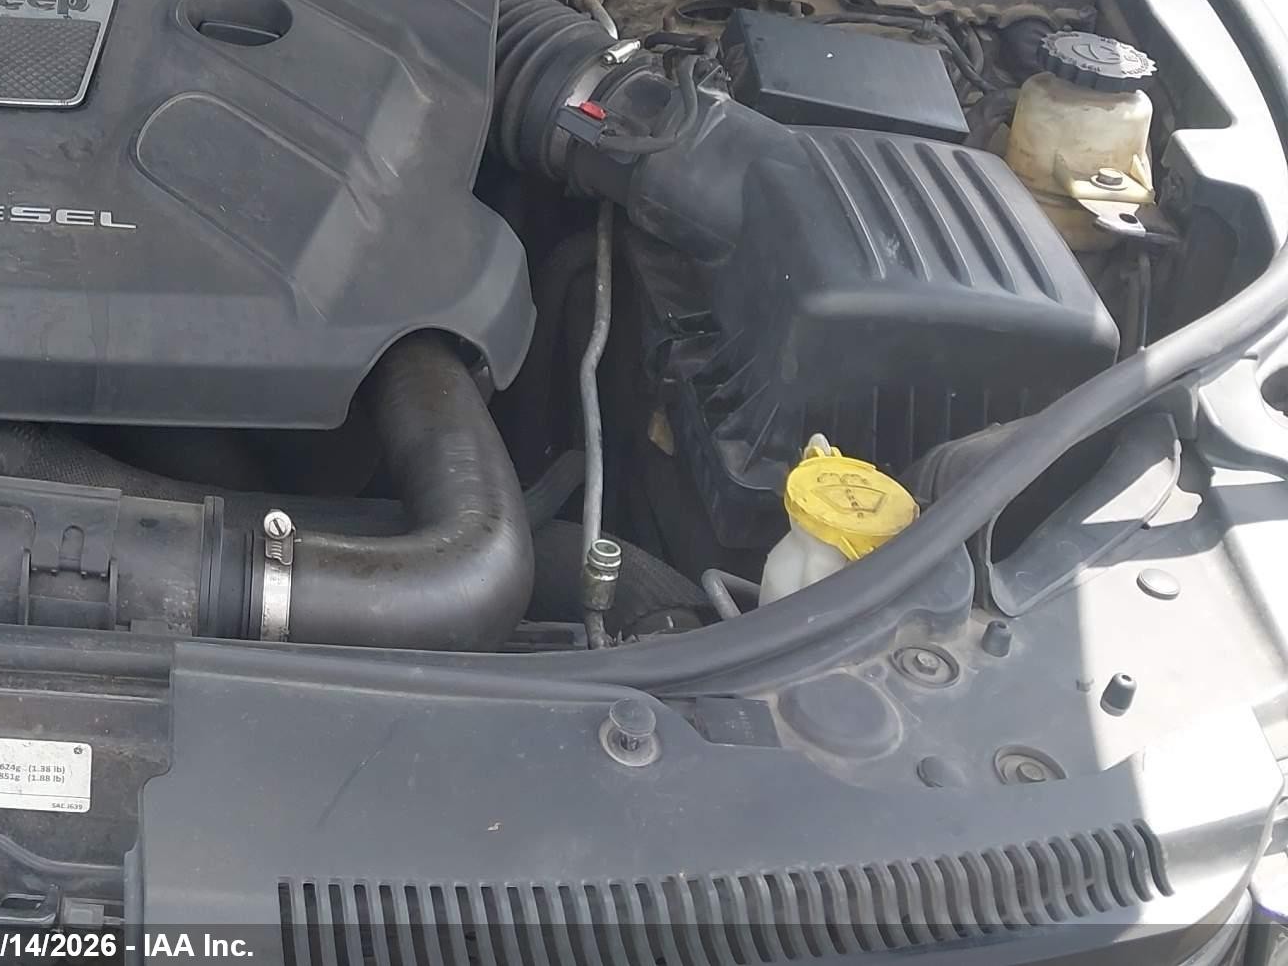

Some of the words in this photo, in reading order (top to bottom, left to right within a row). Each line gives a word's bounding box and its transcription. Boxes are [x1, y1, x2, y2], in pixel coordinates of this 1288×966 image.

[0, 763, 21, 773] 624g
[28, 764, 51, 774] (1.38
[53, 765, 66, 774] lb)
[27, 774, 51, 783] (1.88
[53, 775, 65, 784] lb)
